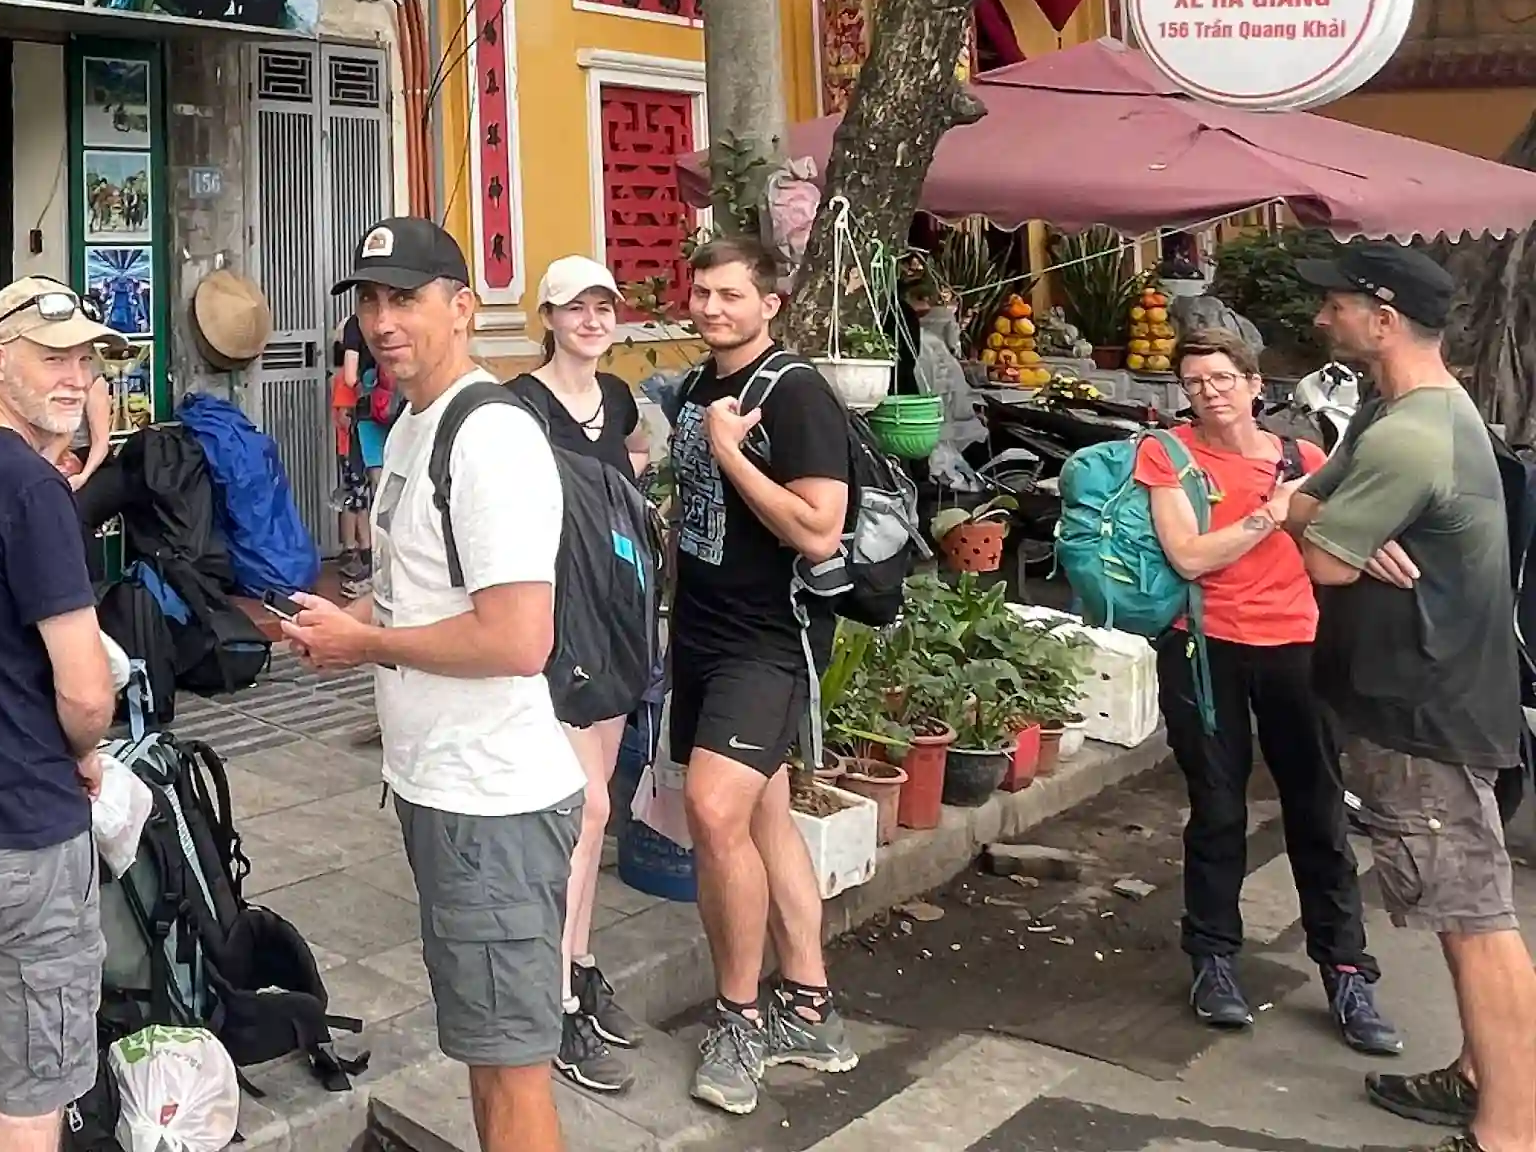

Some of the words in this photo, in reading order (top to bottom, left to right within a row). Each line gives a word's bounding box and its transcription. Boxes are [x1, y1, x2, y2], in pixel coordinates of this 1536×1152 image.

[1158, 21, 1189, 39] 156
[1239, 21, 1296, 40] Quang
[195, 171, 221, 194] 156
